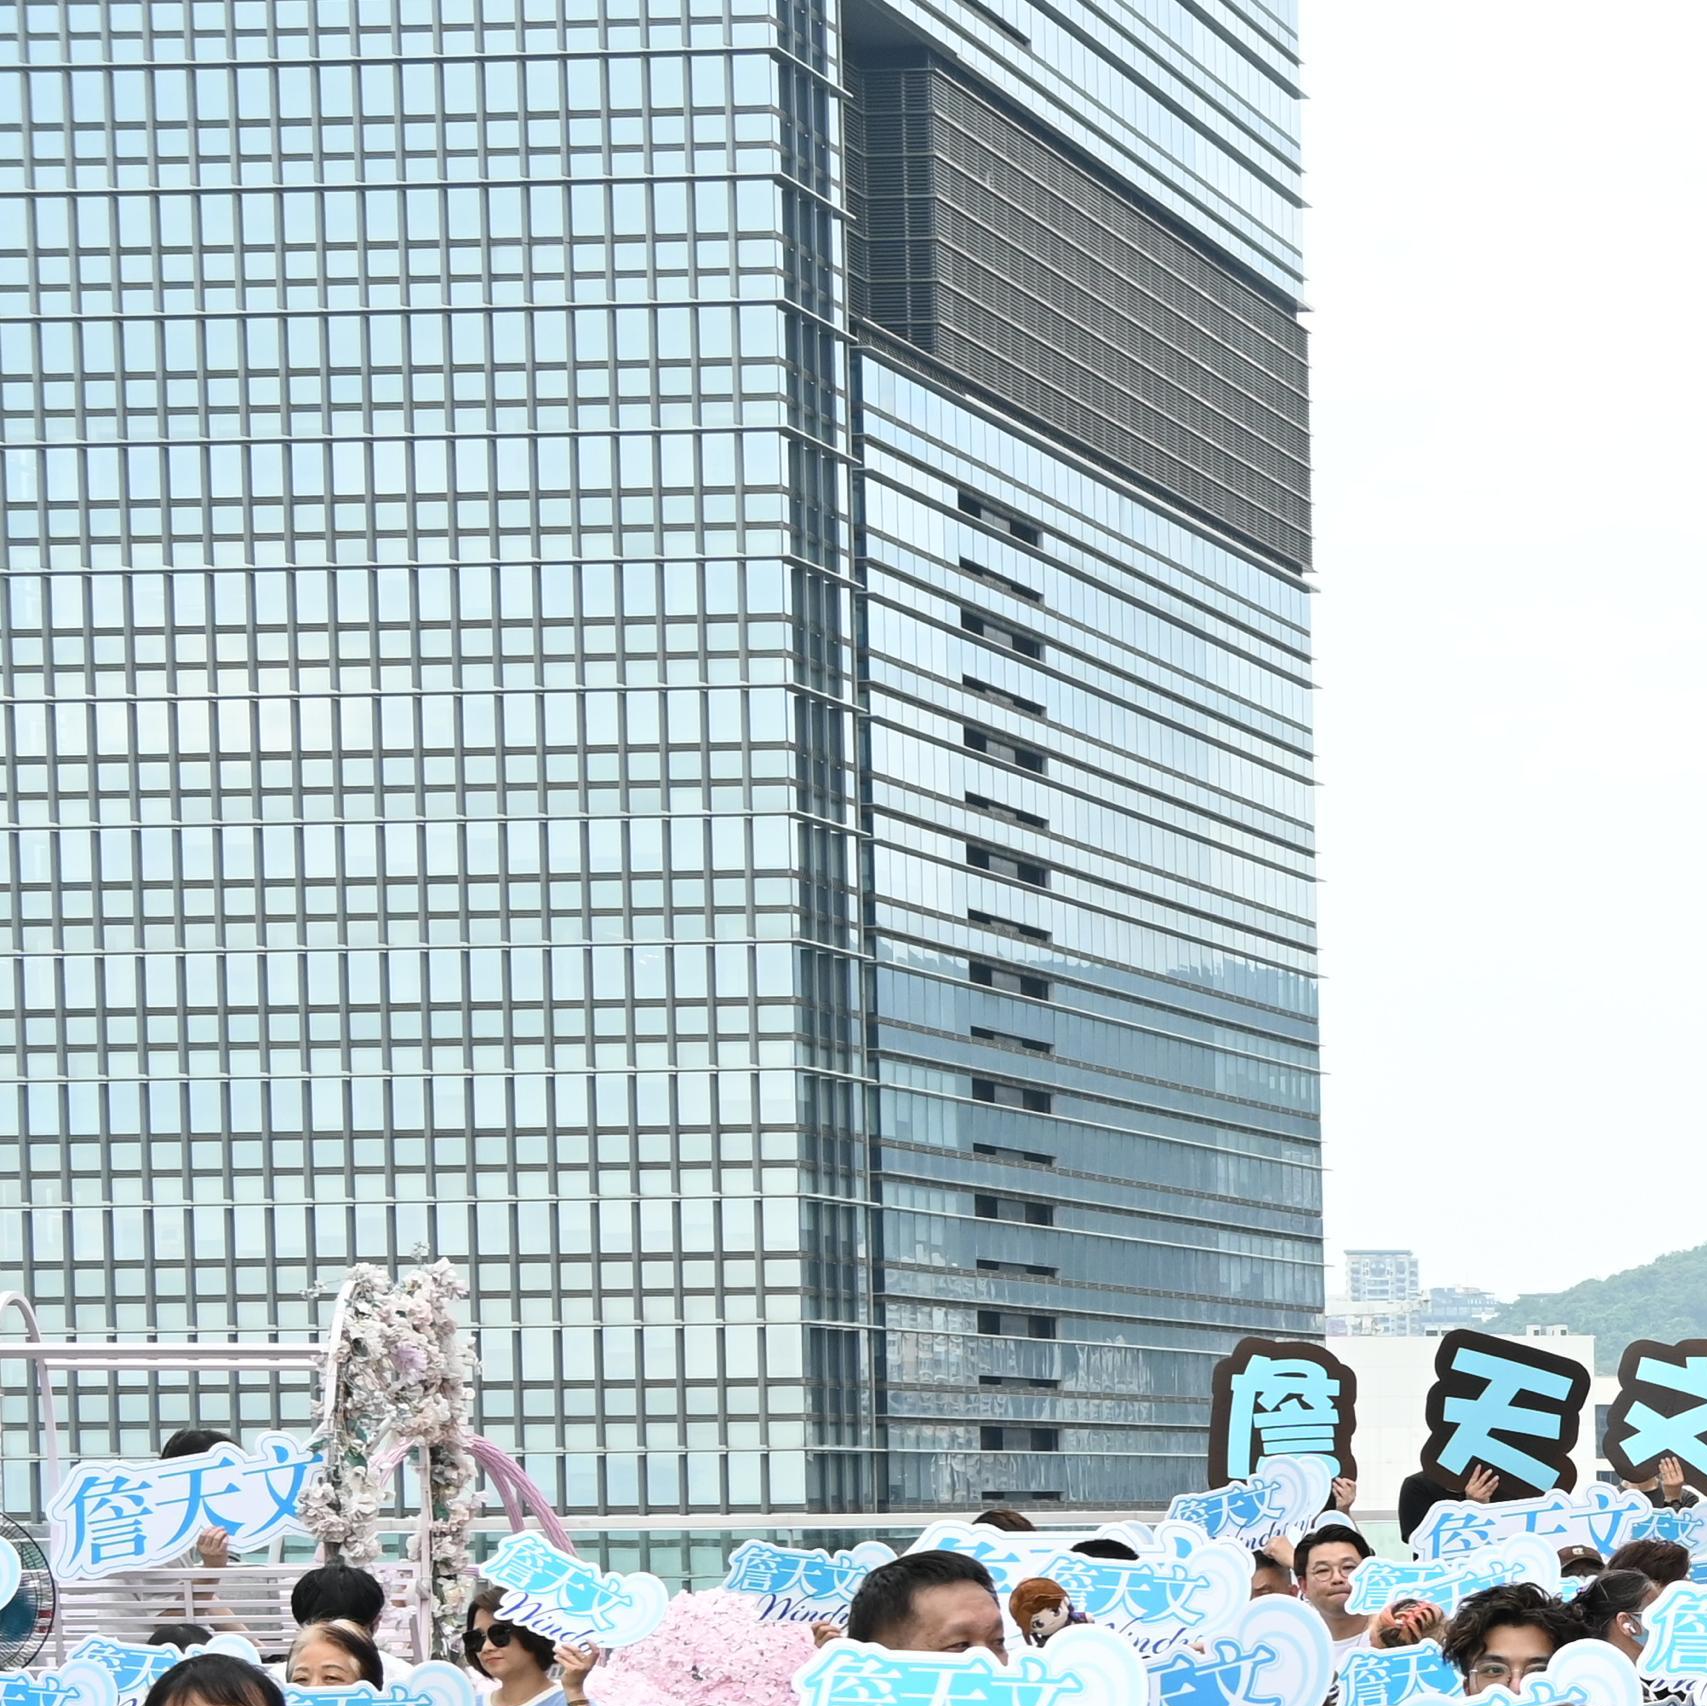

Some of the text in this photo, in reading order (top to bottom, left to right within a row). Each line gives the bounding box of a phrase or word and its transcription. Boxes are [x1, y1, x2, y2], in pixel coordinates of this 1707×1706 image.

[492, 1541, 634, 1632] 詹天文
[731, 1544, 868, 1602] 詹天文
